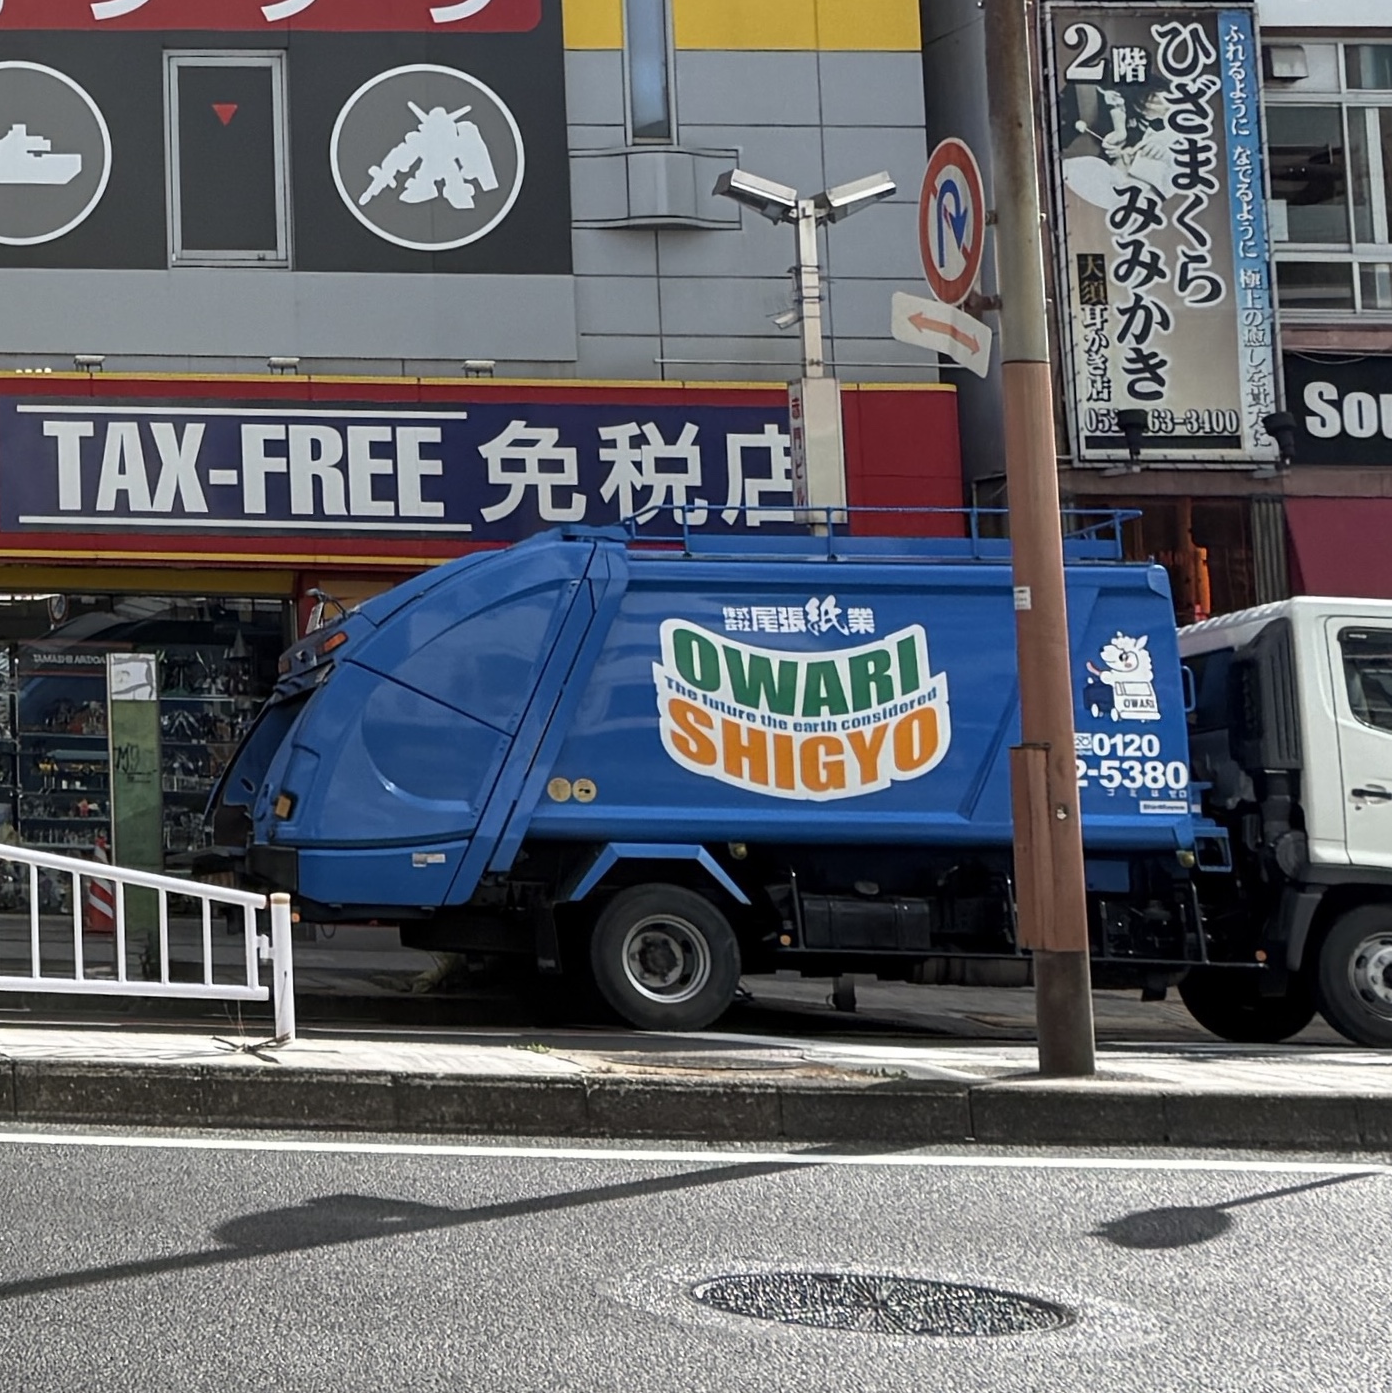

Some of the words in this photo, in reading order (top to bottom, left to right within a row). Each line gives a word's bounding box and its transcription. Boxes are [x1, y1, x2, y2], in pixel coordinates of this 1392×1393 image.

[1064, 23, 1147, 83] 2階
[1224, 25, 1250, 136] ふれるように
[1151, 21, 1225, 306] ひざまくら
[1232, 145, 1258, 258] なでるように
[1106, 184, 1173, 402] みみかき
[43, 420, 445, 518] TAX-FREE
[478, 419, 795, 526] 免税店
[665, 675, 697, 702] The
[701, 693, 757, 724] future
[760, 713, 788, 731] the
[793, 719, 838, 733] earth
[841, 686, 938, 731] considered
[673, 628, 920, 717] OWARI
[668, 698, 939, 792] SHIGYO
[1092, 732, 1160, 757] 0120
